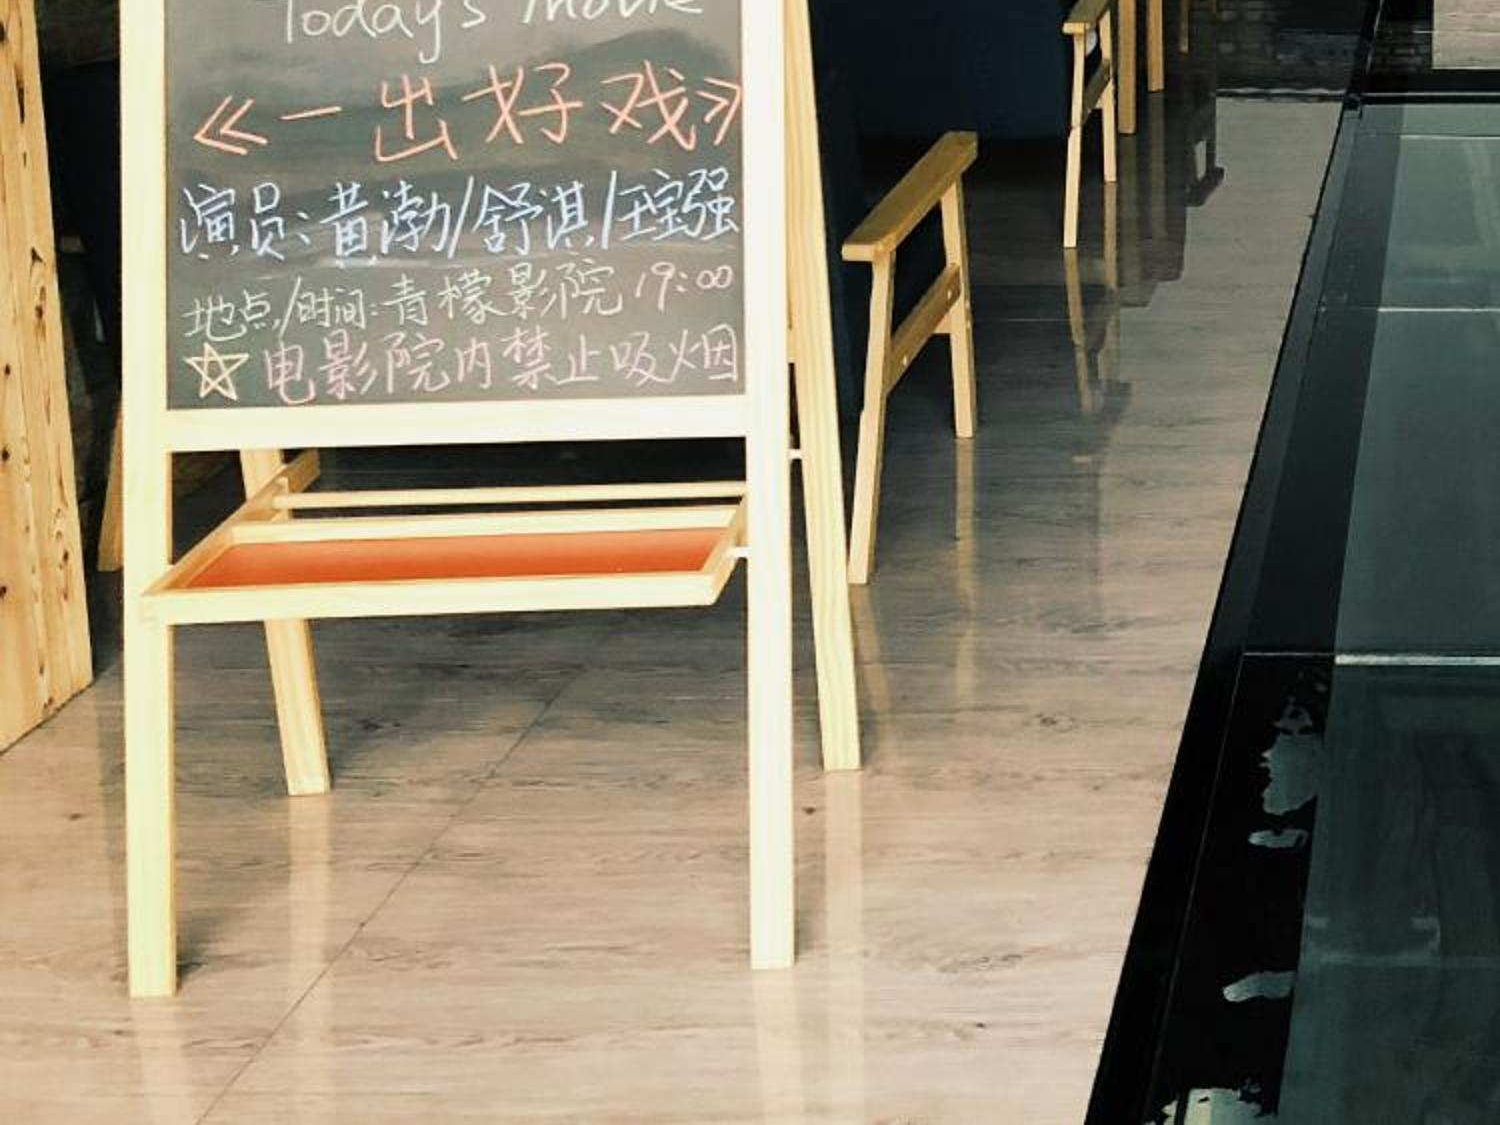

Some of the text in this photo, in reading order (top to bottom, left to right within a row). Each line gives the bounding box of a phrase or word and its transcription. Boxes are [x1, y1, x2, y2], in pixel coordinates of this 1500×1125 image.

[263, 323, 739, 405] 电影院内禁止吸烟
